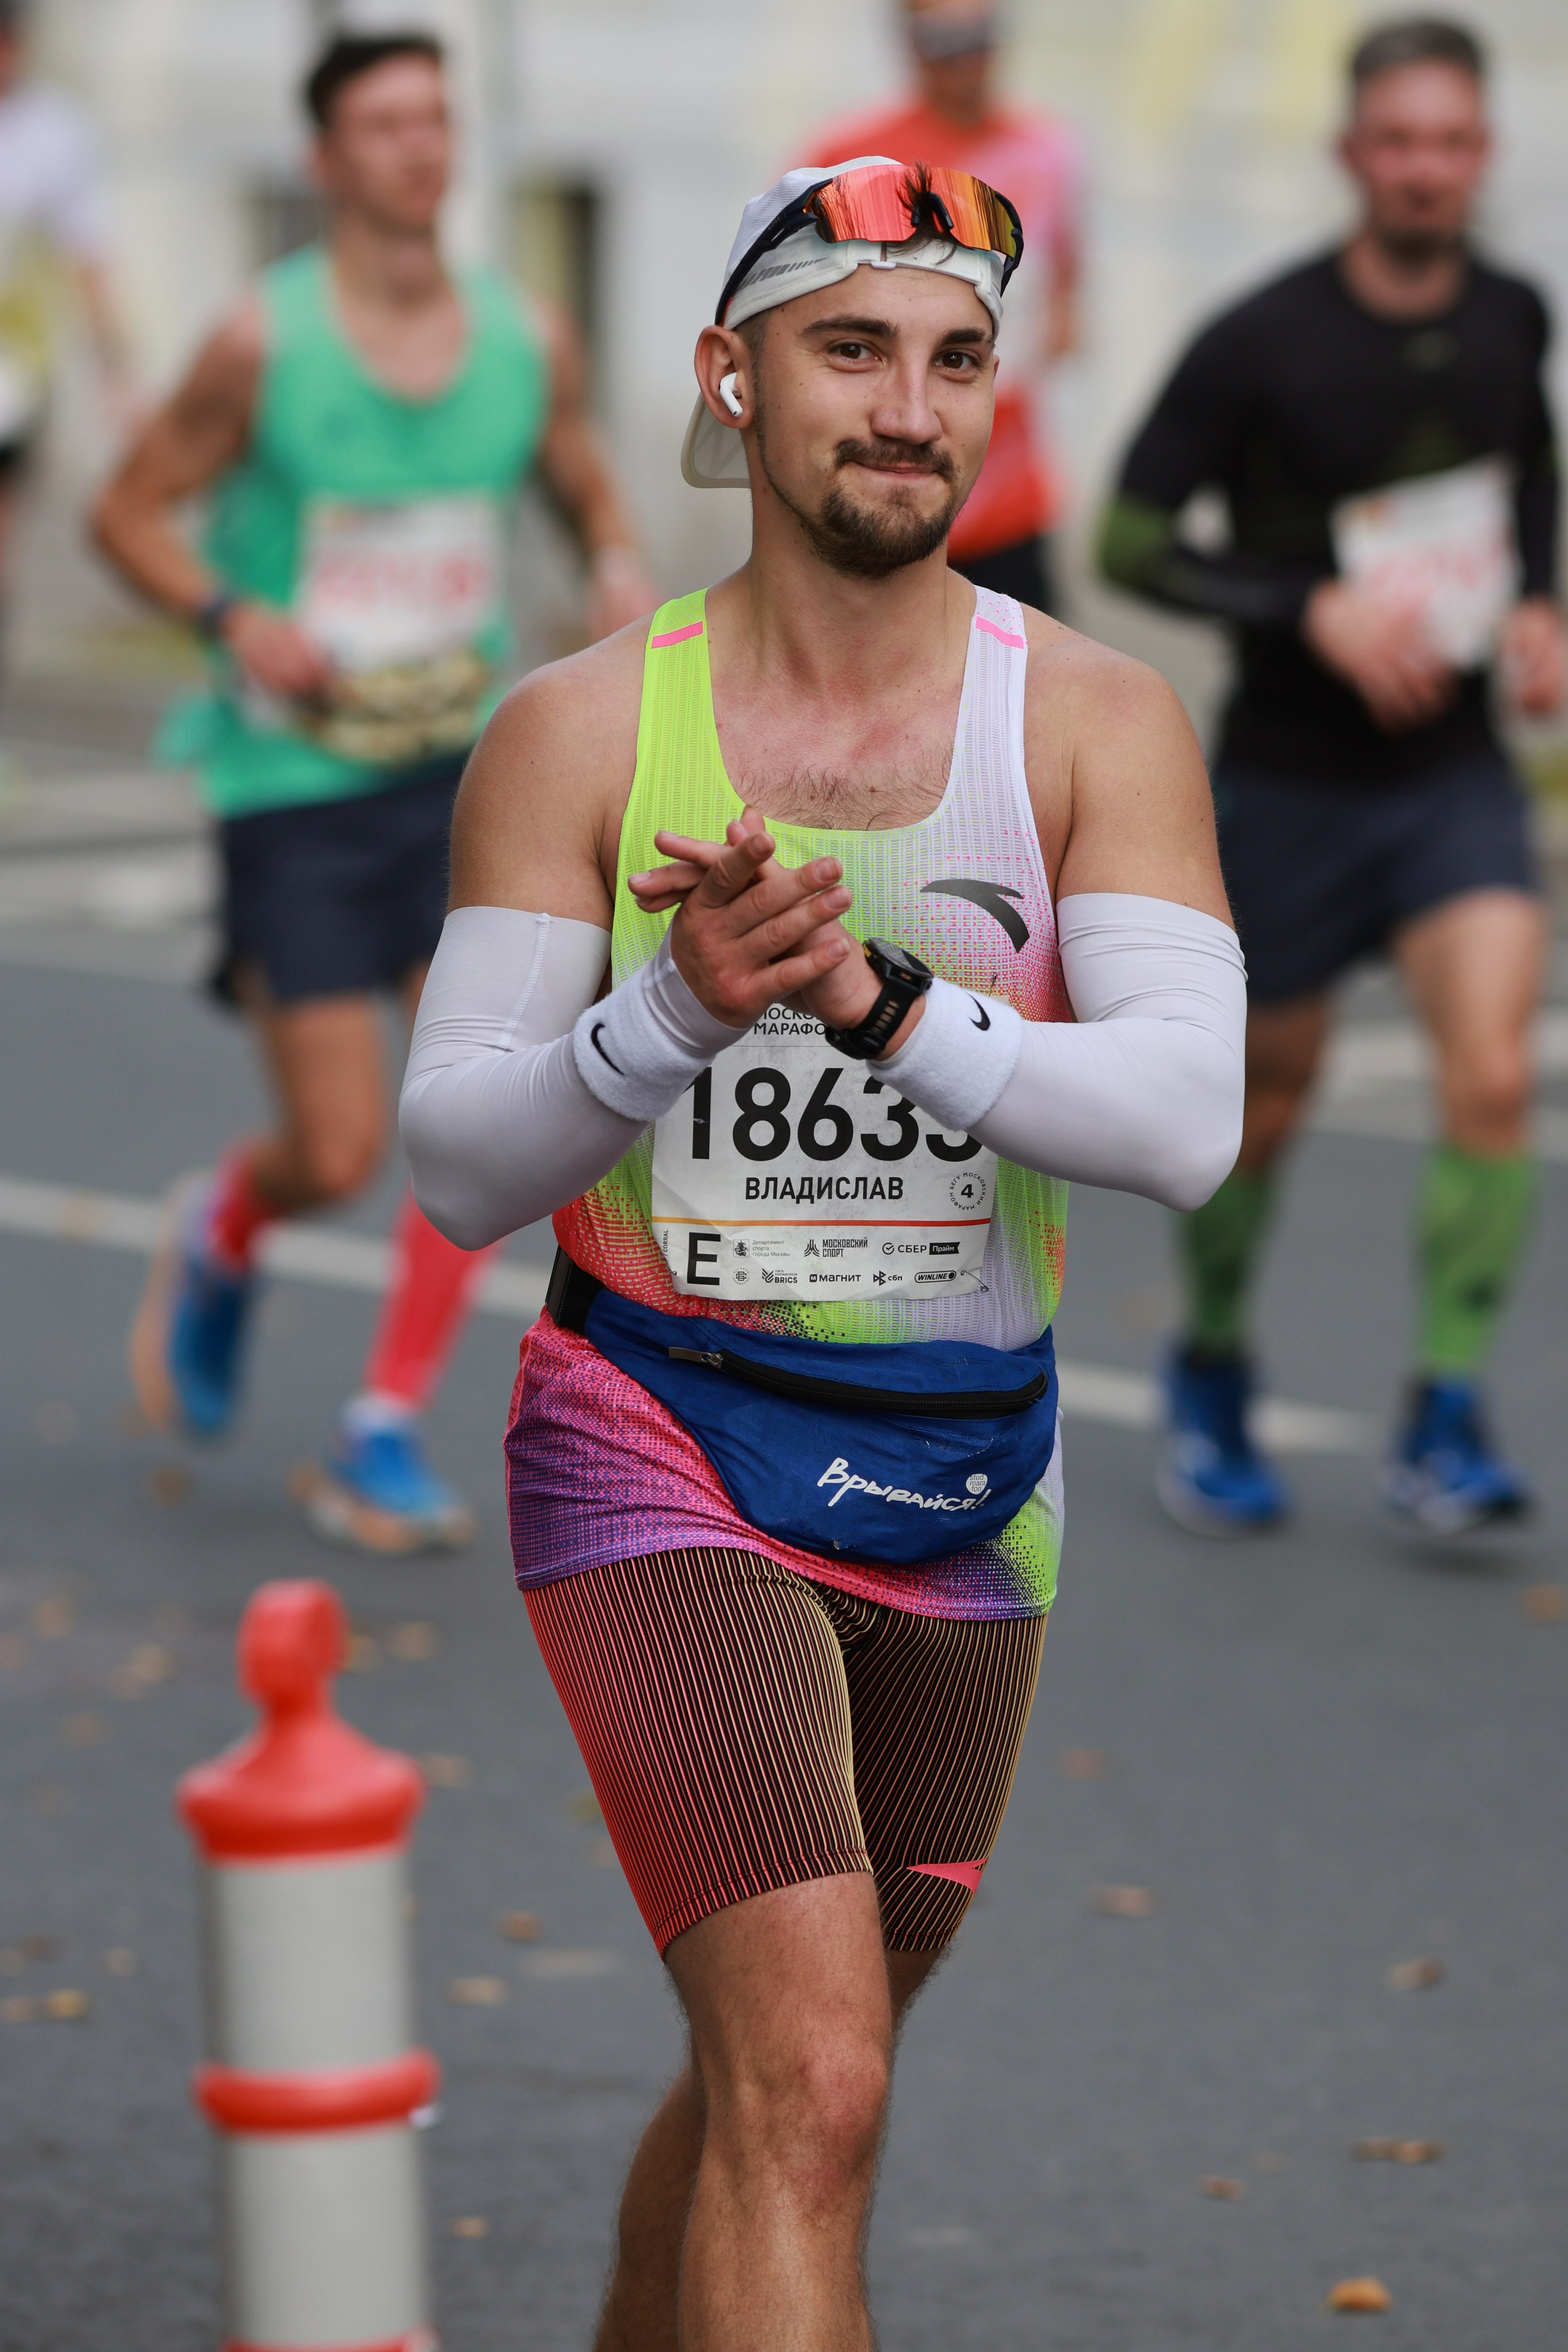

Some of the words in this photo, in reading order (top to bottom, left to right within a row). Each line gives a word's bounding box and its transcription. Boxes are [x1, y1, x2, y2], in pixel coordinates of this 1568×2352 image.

[754, 1023, 826, 1035] МАРАФО
[949, 1175, 960, 1189] БЕГУ
[963, 1172, 986, 1205] МОСКОВСКИЙ
[745, 1177, 904, 1204] ВЛАДИСЛАВ
[961, 1184, 974, 1198] 4
[949, 1192, 975, 1210] МАРАФОН
[822, 1237, 868, 1248] МОСКОВСКИЙ
[897, 1245, 927, 1253] СБЕР
[932, 1245, 955, 1253] Прайм
[822, 1248, 844, 1257] СПОРТ
